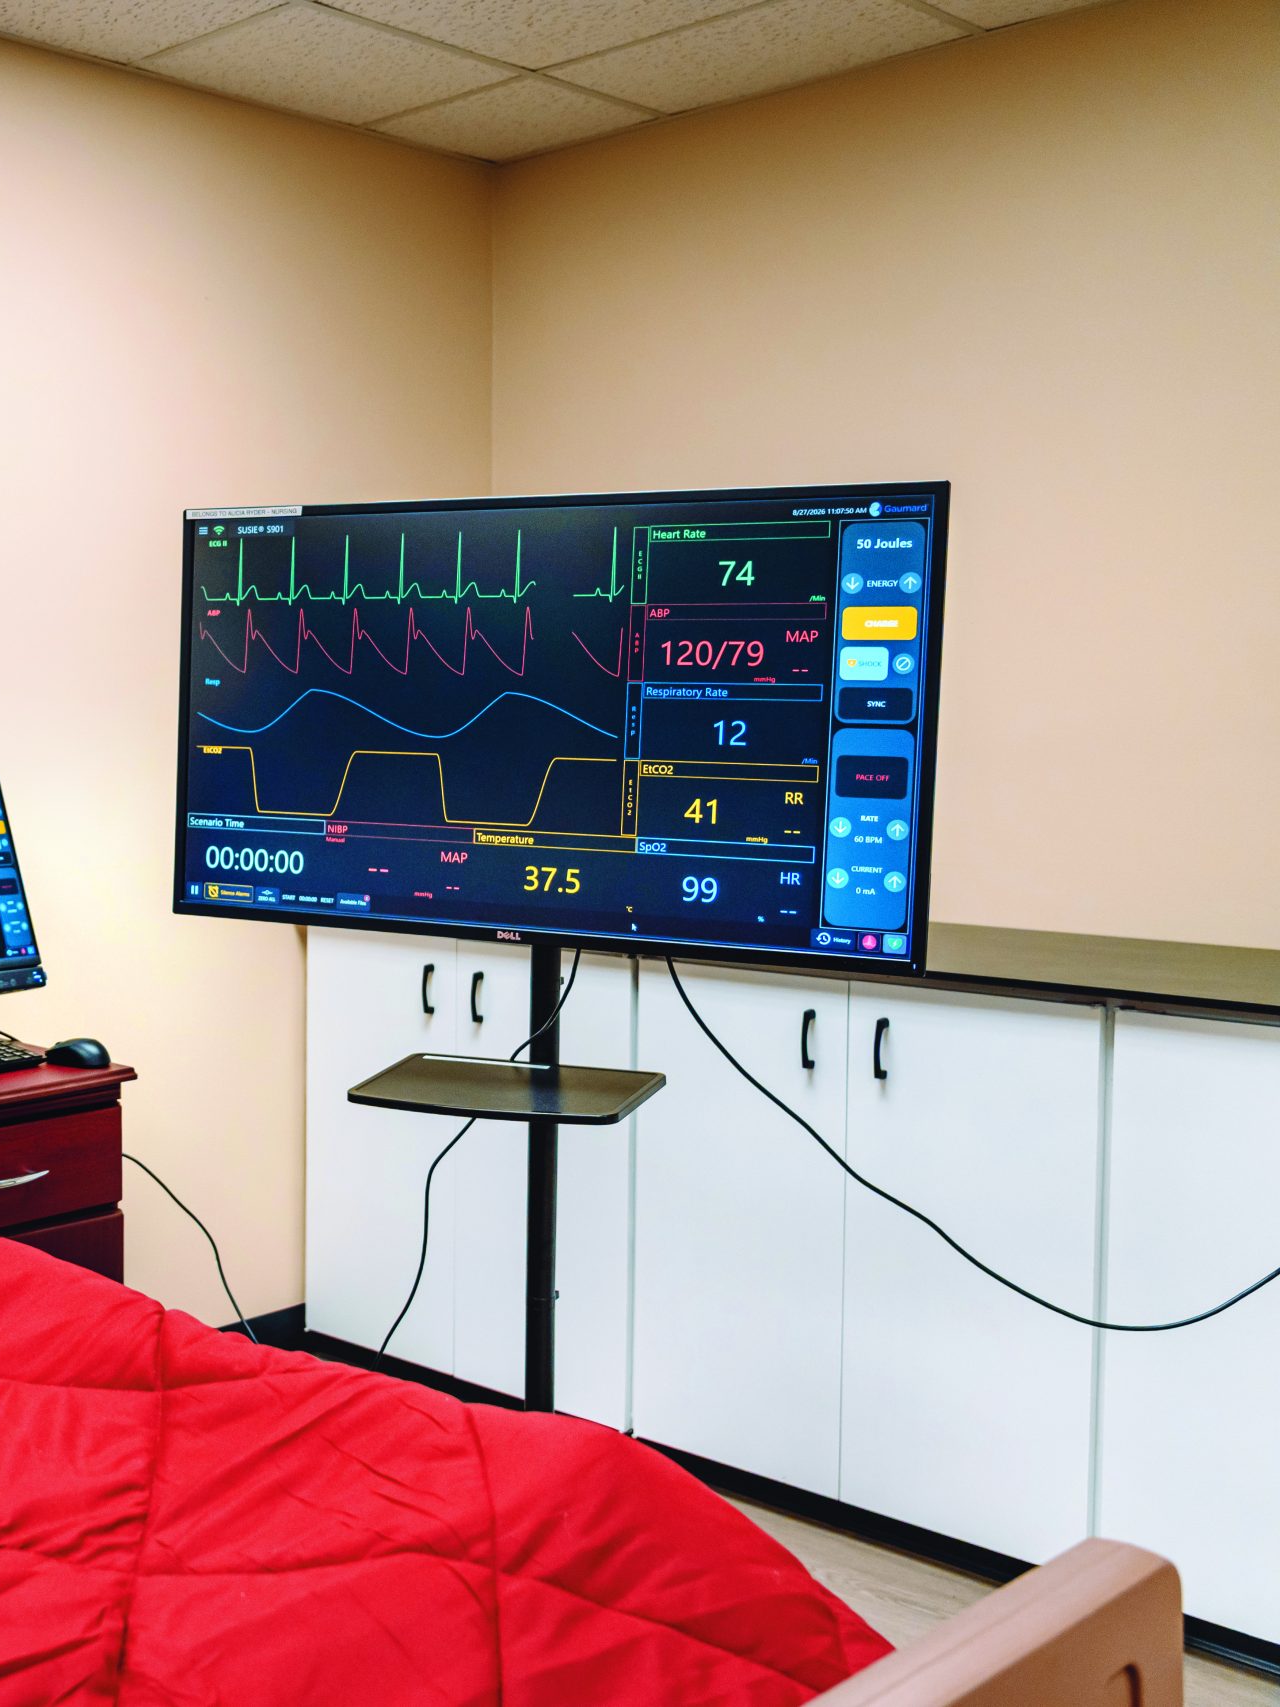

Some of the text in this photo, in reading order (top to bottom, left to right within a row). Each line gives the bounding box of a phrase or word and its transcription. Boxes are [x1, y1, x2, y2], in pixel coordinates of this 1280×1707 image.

[884, 504, 928, 513] Gaumard
[237, 525, 284, 534] SUSIE® S901
[653, 529, 706, 539] Heart Rate
[856, 538, 912, 549] 50 Joules
[718, 560, 755, 586] 74
[866, 580, 898, 588] ENERGY
[649, 608, 670, 618] ABP
[785, 630, 819, 643] MAP
[661, 640, 764, 670] 120/79
[205, 678, 220, 687] Resp
[646, 687, 728, 699] Respiratory Rate
[713, 720, 747, 746] 12
[642, 765, 673, 775] EtCO2
[784, 792, 804, 805] RR
[684, 798, 718, 824] 41
[190, 816, 244, 828] Scenario Time
[328, 825, 348, 834] NIBP
[477, 832, 534, 845] Temperature
[854, 836, 864, 844] 60
[639, 842, 666, 853] SpO2
[206, 845, 304, 875] 00:00:00
[440, 851, 468, 864] MAP
[851, 866, 883, 874] CURRENT
[523, 866, 581, 894] 37.5
[779, 872, 801, 885] HR
[682, 876, 718, 903] 99
[497, 931, 521, 941] DELL
[833, 937, 852, 945] History
